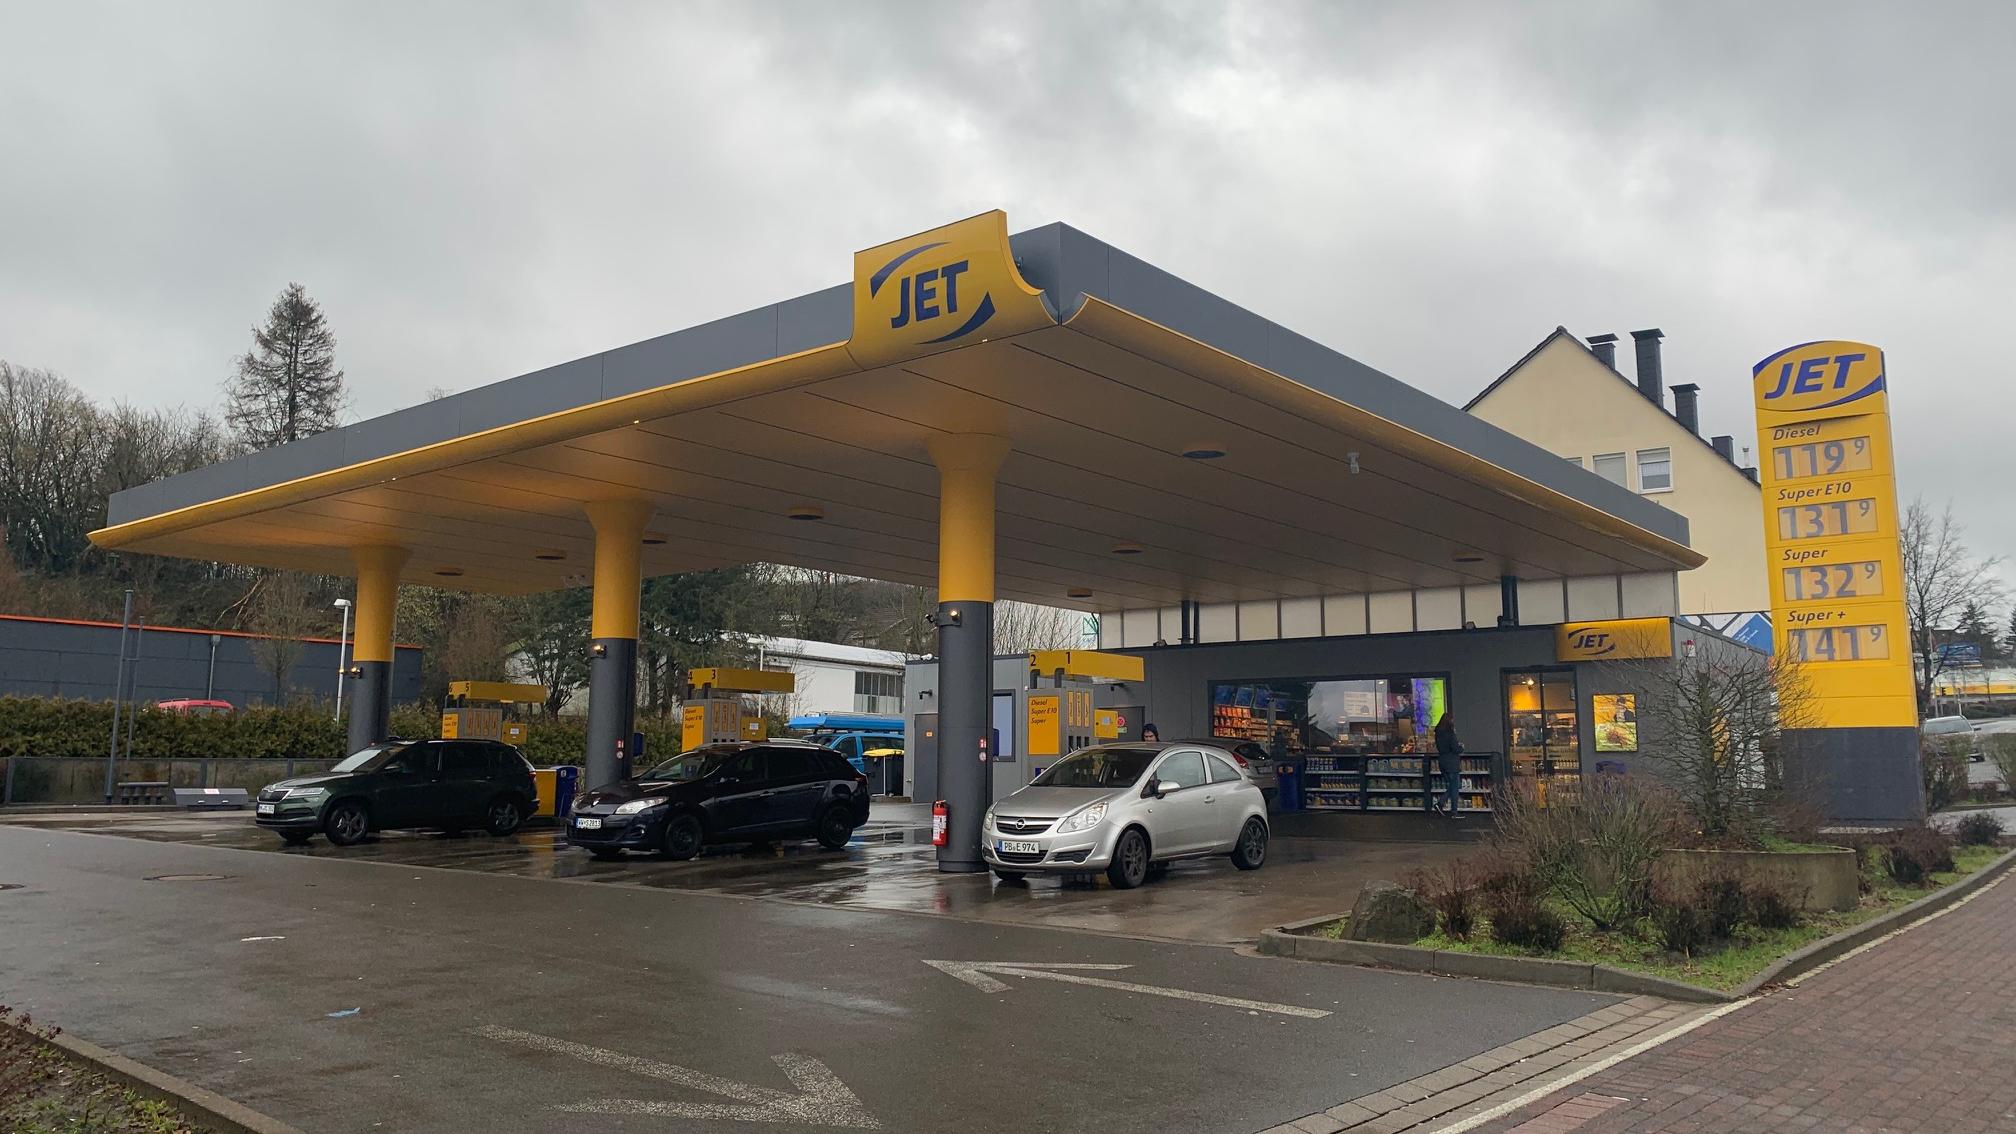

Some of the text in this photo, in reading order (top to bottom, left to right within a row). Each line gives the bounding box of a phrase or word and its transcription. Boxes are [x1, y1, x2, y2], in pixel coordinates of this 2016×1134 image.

[890, 260, 969, 329] JET
[1763, 353, 1866, 400] JET
[1773, 424, 1822, 441] Diesel
[1778, 481, 1852, 502] Super E10
[1783, 549, 1828, 563] Super
[1787, 610, 1833, 625] Super
[1573, 633, 1610, 649] JET
[1030, 654, 1036, 667] 2
[1066, 651, 1071, 665] 1
[688, 670, 693, 680] 4
[711, 669, 717, 680] 3
[465, 682, 470, 692] 5
[1031, 698, 1048, 706] Diesel
[1031, 708, 1047, 717] Super
[1031, 718, 1046, 726] Super
